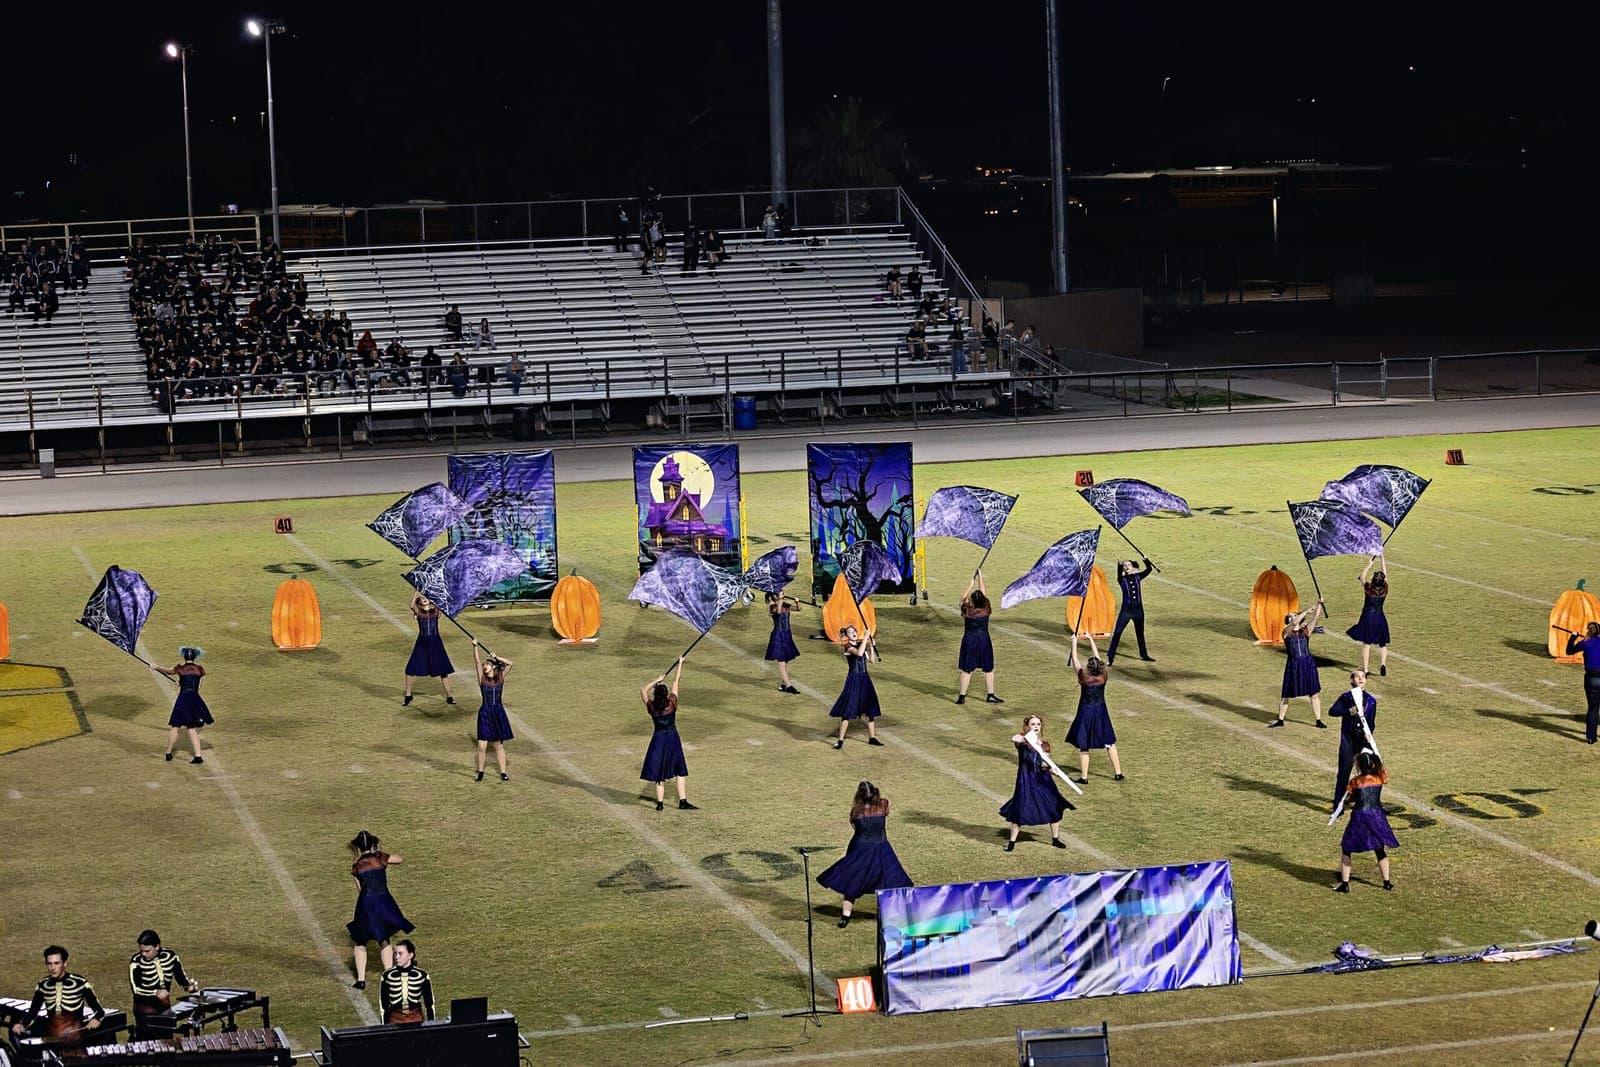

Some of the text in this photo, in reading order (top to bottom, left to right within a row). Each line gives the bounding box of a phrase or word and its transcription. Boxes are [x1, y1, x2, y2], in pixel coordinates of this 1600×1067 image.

[1450, 450, 1464, 464] 10
[1079, 471, 1094, 485] 20
[277, 518, 293, 532] 40
[597, 849, 804, 895] 40
[843, 979, 873, 1010] 40
